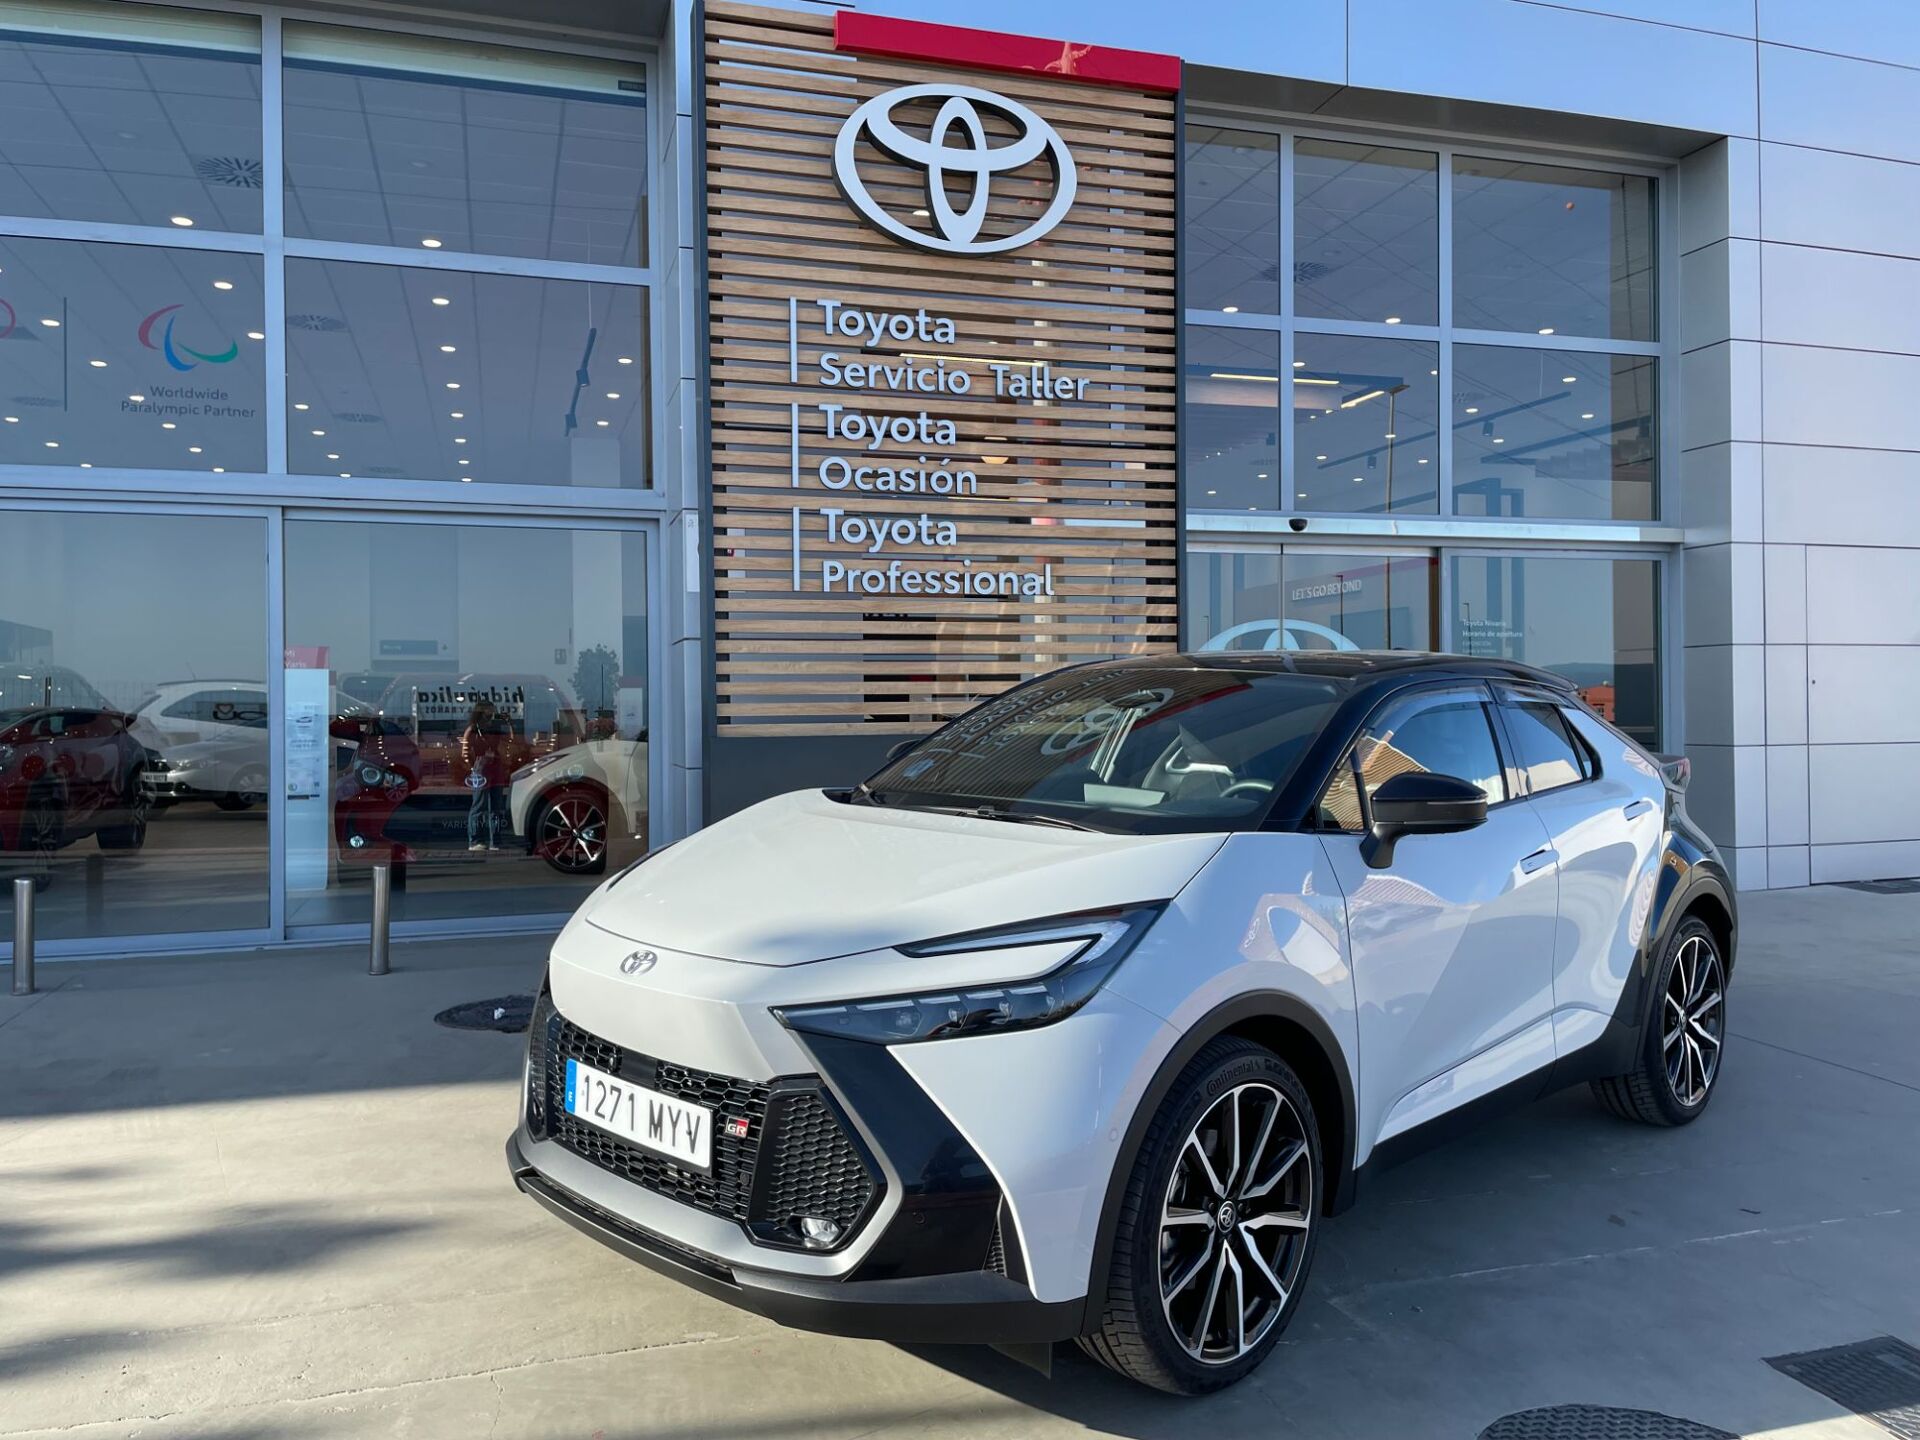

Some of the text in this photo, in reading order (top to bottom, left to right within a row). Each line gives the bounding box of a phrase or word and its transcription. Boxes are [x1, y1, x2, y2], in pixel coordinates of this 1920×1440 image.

[817, 299, 955, 347] Toyota
[149, 385, 229, 400] Worldwide
[819, 352, 1090, 400] Servicio Taller
[121, 400, 256, 418] Paralympic Partner
[818, 403, 956, 450] Toyota
[819, 456, 977, 494] Ocasión
[820, 508, 957, 553] Toyota
[822, 559, 1055, 596] Professional
[1313, 584, 1327, 598] GO
[1327, 580, 1362, 596] BEYOND
[584, 1074, 635, 1131] 1271
[649, 1099, 701, 1154] MYV
[727, 1122, 748, 1137] GR
